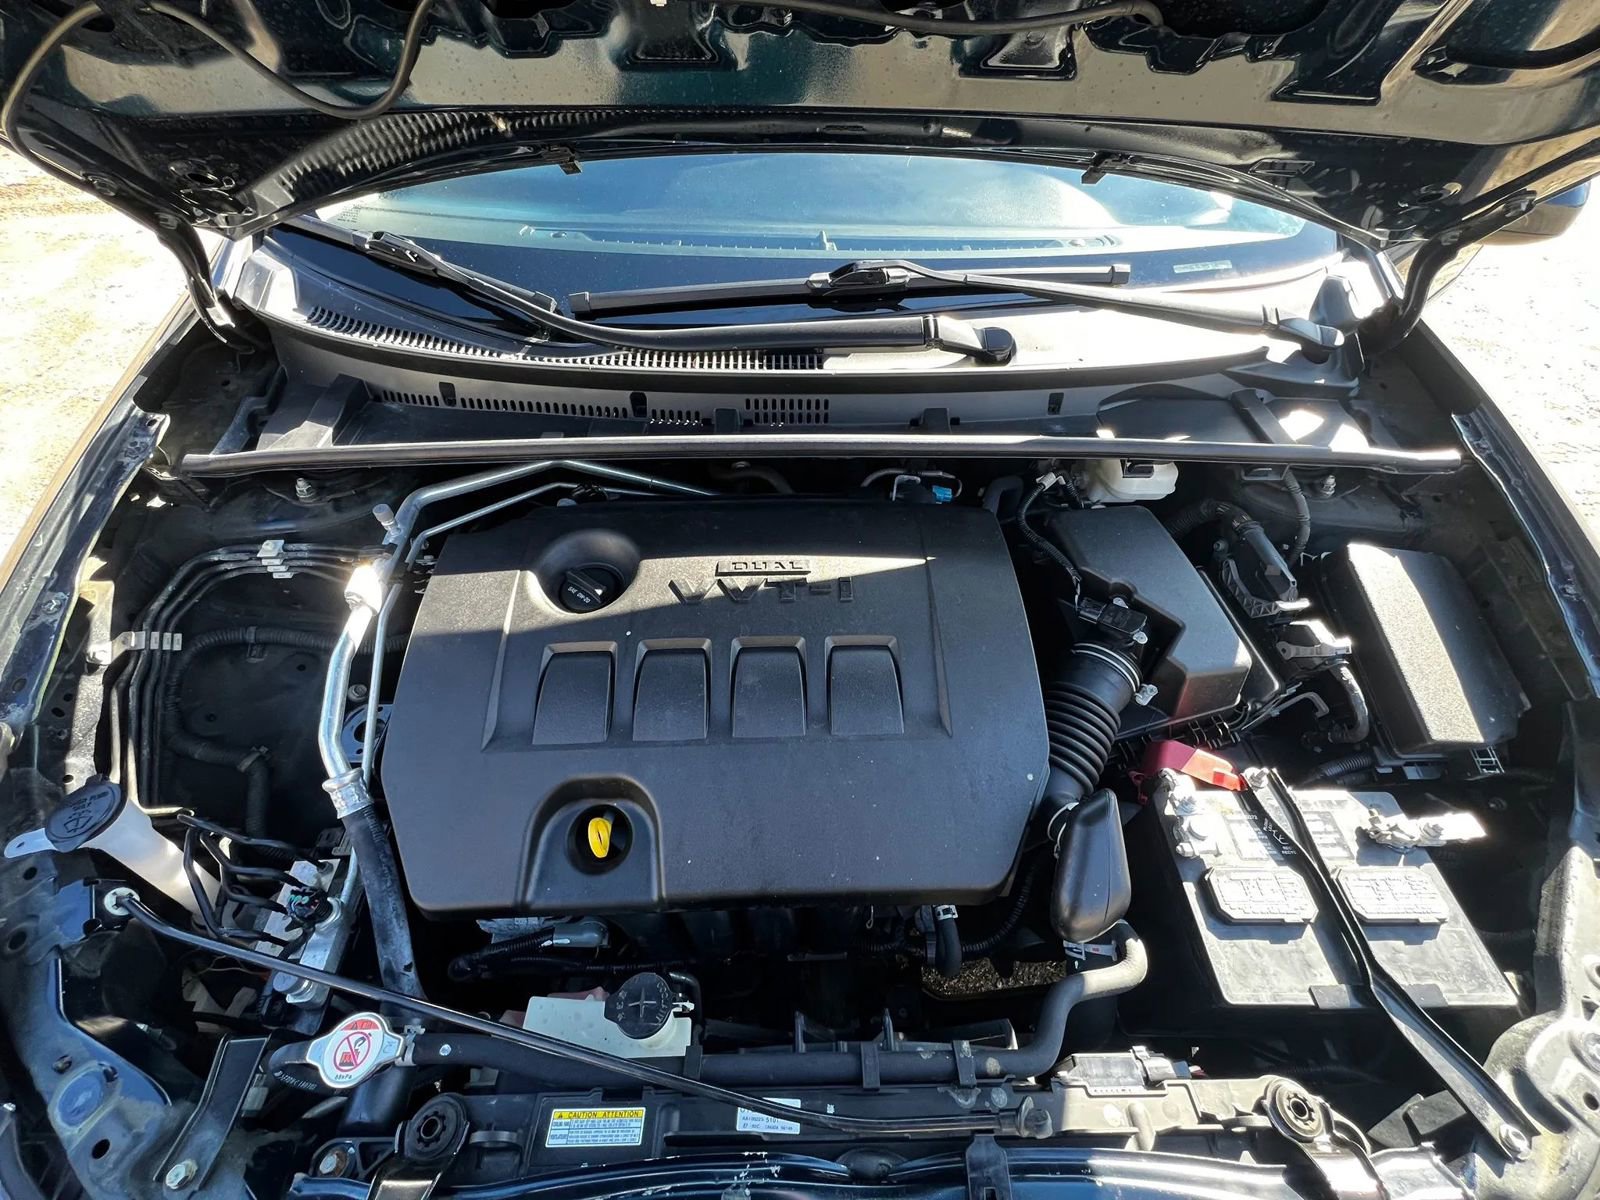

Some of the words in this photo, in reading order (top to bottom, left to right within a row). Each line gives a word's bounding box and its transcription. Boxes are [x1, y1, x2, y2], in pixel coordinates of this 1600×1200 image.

[731, 561, 804, 571] DUAL
[568, 1111, 598, 1119] CAUTION
[602, 1110, 639, 1118] ATTENTION
